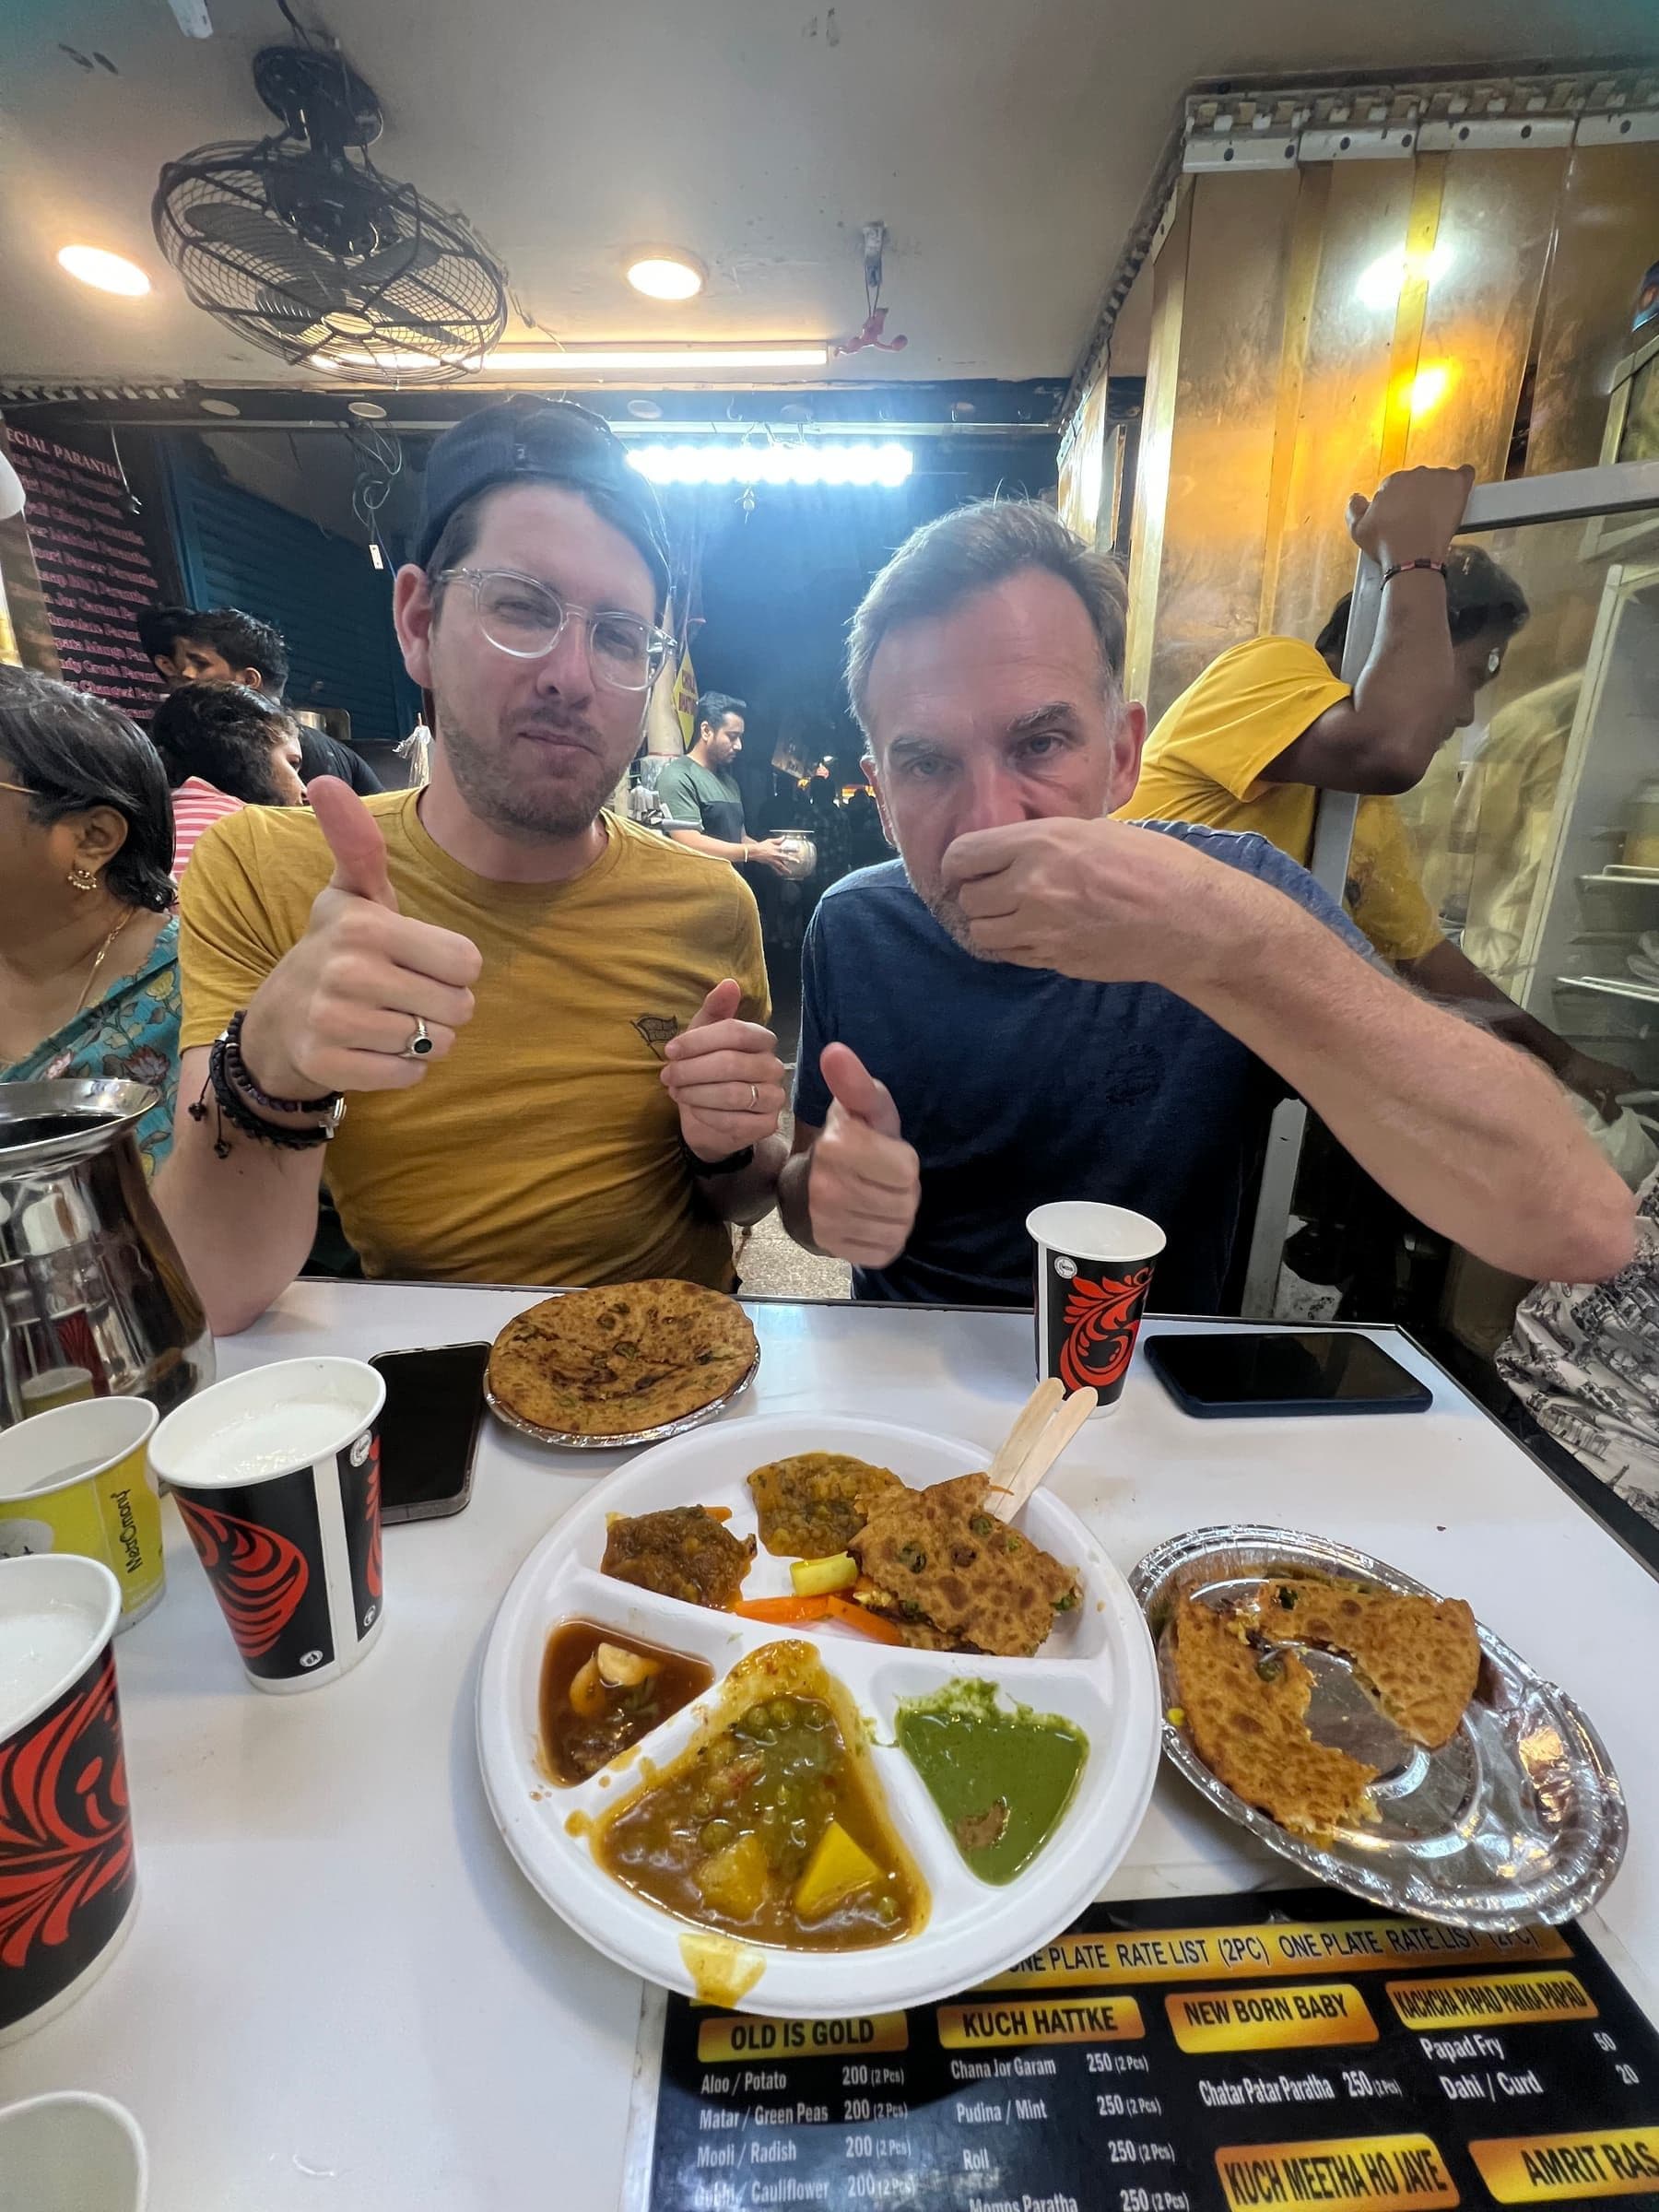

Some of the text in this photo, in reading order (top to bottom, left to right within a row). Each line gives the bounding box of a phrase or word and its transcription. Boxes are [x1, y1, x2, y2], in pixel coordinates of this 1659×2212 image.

[6, 428, 50, 454] ECIAL
[1049, 1944, 1110, 1971] PLATE
[1116, 1942, 1168, 1967] RATE
[1168, 1938, 1209, 1965] LIST
[1218, 1936, 1270, 1969] (2PC)
[1279, 1934, 1322, 1959] ONE
[1323, 1931, 1382, 1957] PLATE
[1386, 1927, 1440, 1952] RATE
[1183, 1994, 1348, 2027] NEW BORN BABY
[1393, 1980, 1588, 2018] KACHCHA PAPAD PAKKA PAPAD
[731, 2019, 875, 2050] OLD IS GOLD
[962, 2006, 1118, 2038] KUCH HATTKE
[1419, 2031, 1617, 2065] Papad Fry 50
[700, 2074, 729, 2094] Aloo
[744, 2071, 787, 2092] Potato
[842, 2065, 867, 2086] 200
[950, 2058, 992, 2079] Chana
[994, 2058, 1012, 2077] Jor
[1013, 2056, 1056, 2077] Garam
[1087, 2053, 1113, 2073] 250
[1439, 2074, 1485, 2100] Dahi
[1497, 2070, 1544, 2096] Curd
[1616, 2064, 1640, 2085] 20
[1199, 2079, 1244, 2107] Chatar
[1242, 2077, 1283, 2104] Patar
[1278, 2073, 1335, 2101] Paratha
[1342, 2070, 1373, 2097] 250
[700, 2109, 739, 2131] Matar
[754, 2104, 794, 2126] Green
[796, 2101, 829, 2124] Peas
[844, 2099, 870, 2121] 200
[957, 2101, 1002, 2124] Pudina
[1015, 2099, 1047, 2120] Mint
[1097, 2094, 1124, 2116] 250
[697, 2144, 735, 2168] Mooli
[750, 2139, 796, 2164] Radish
[845, 2136, 873, 2158] 200
[963, 2148, 990, 2171] Roll
[1108, 2140, 1136, 2162] 250
[1521, 2141, 1659, 2187] AMRIT RAS
[751, 2176, 830, 2204] Cauliflower
[848, 2171, 875, 2197] 200
[1223, 2148, 1448, 2206] KUCH MEETHA HO JAYE
[1022, 2193, 1078, 2212] Paratha
[1120, 2188, 1148, 2211] 250
